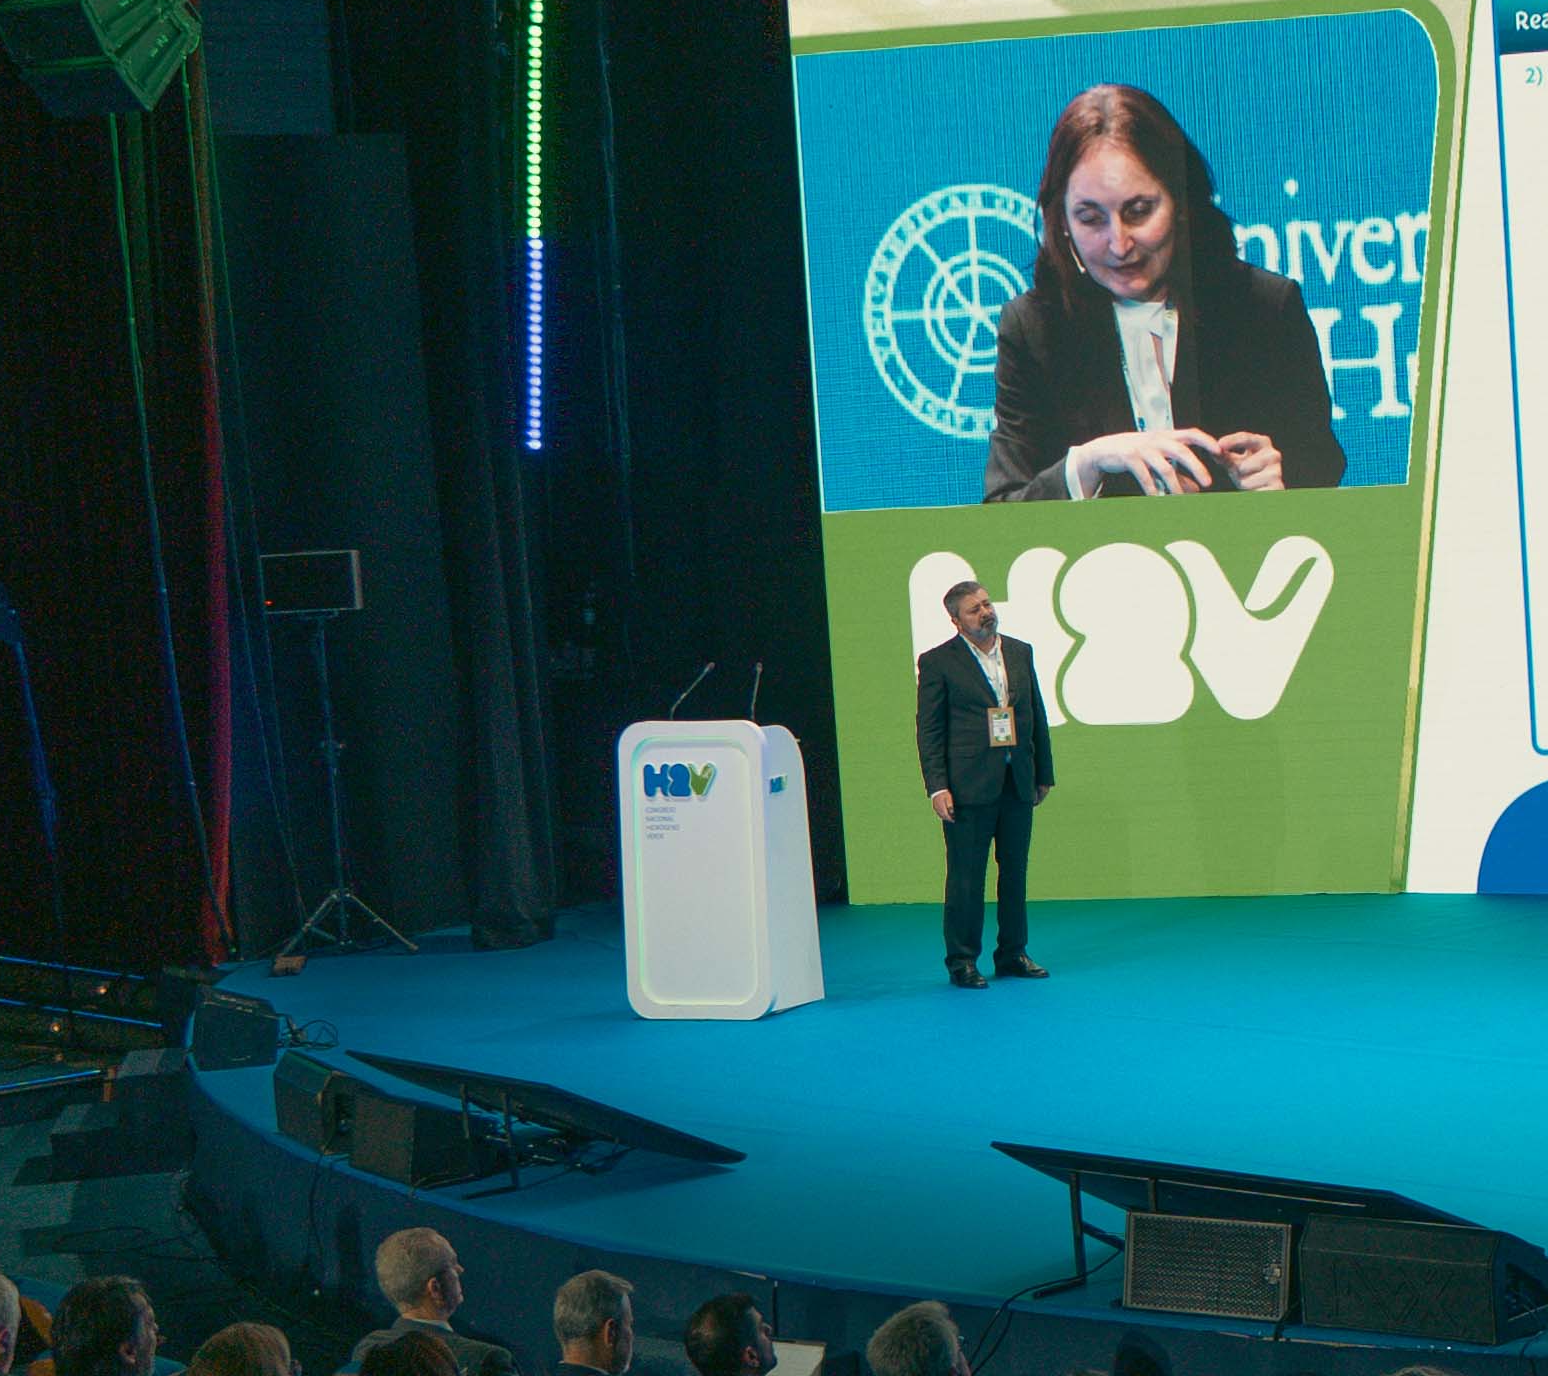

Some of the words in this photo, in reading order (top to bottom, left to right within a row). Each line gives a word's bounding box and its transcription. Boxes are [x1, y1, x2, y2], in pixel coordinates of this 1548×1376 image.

[1525, 67, 1543, 85] 2)
[1213, 179, 1430, 286] niver
[1308, 302, 1420, 420] H
